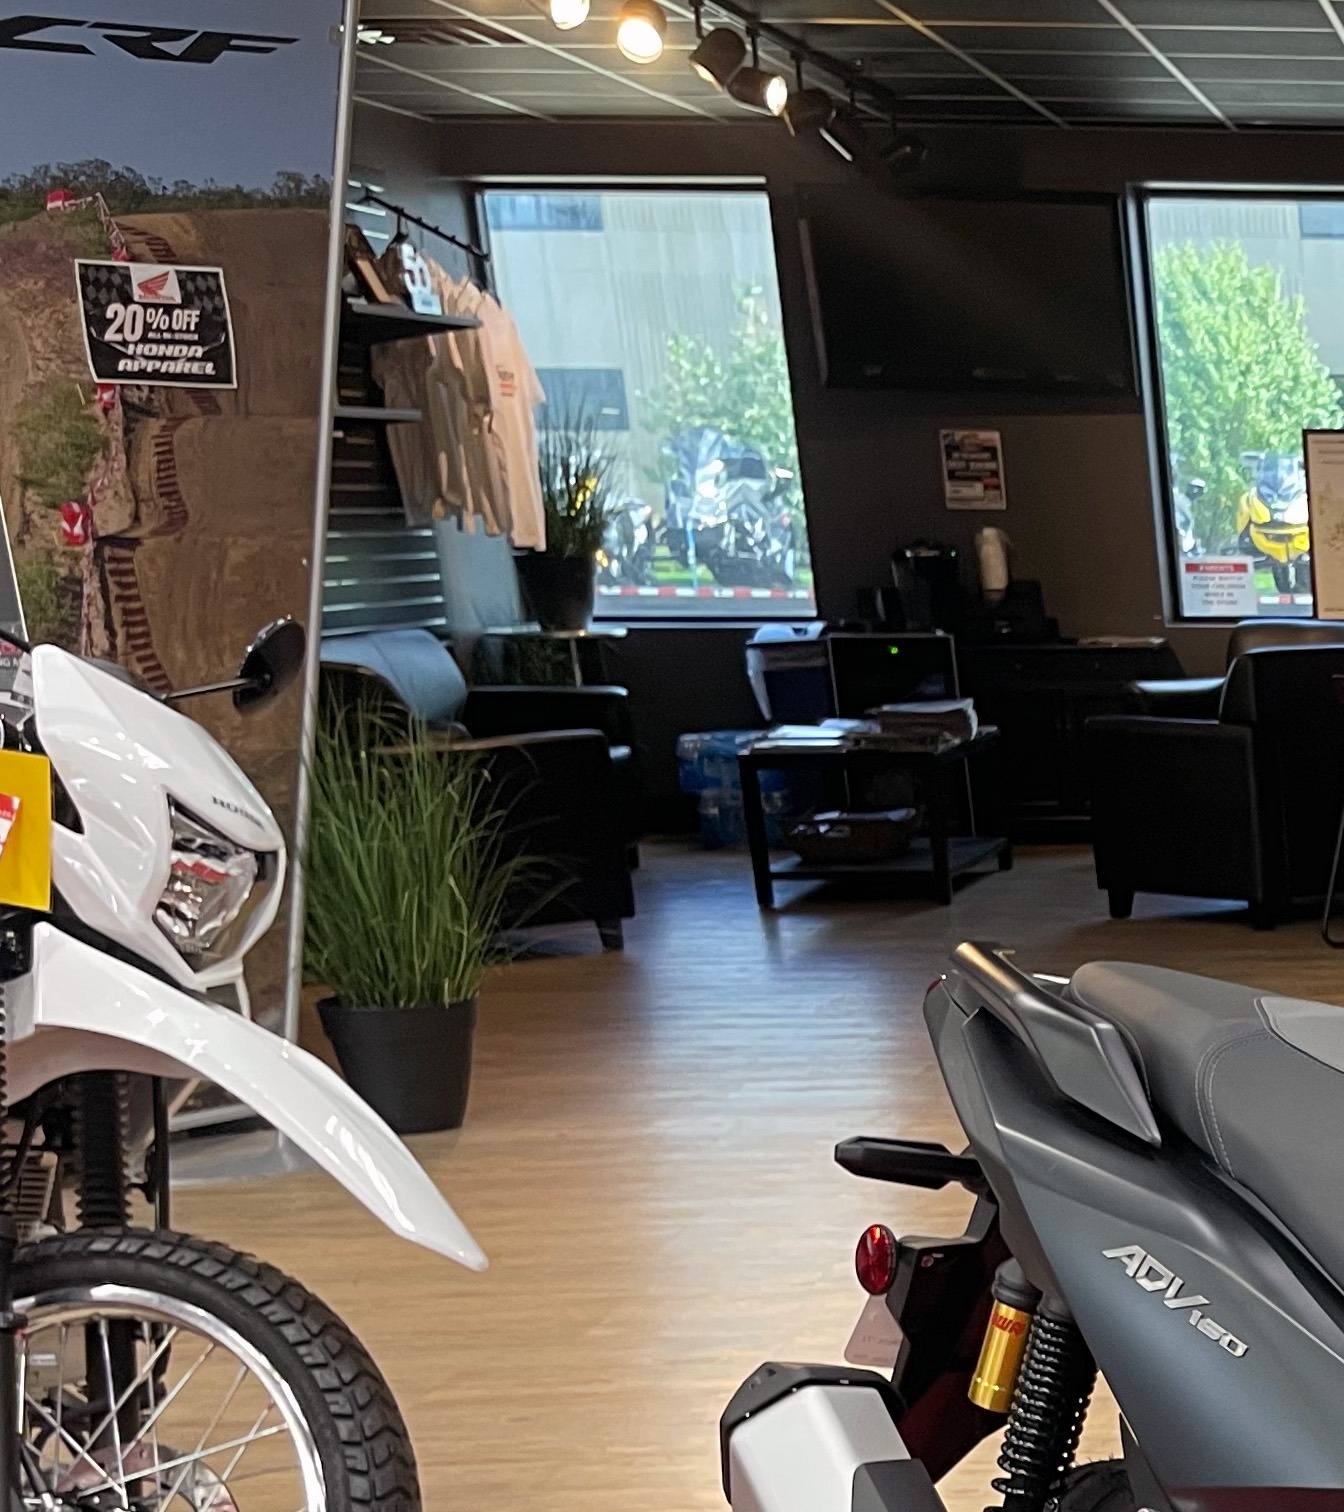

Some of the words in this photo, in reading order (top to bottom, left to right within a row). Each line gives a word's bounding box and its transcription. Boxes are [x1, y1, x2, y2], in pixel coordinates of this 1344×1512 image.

[104, 302, 170, 343] 20%
[171, 309, 200, 331] OFF
[127, 343, 203, 358] HONDA
[117, 359, 216, 375] APPAREL
[1101, 1244, 1211, 1310] ADV
[1188, 1309, 1249, 1358] 160
